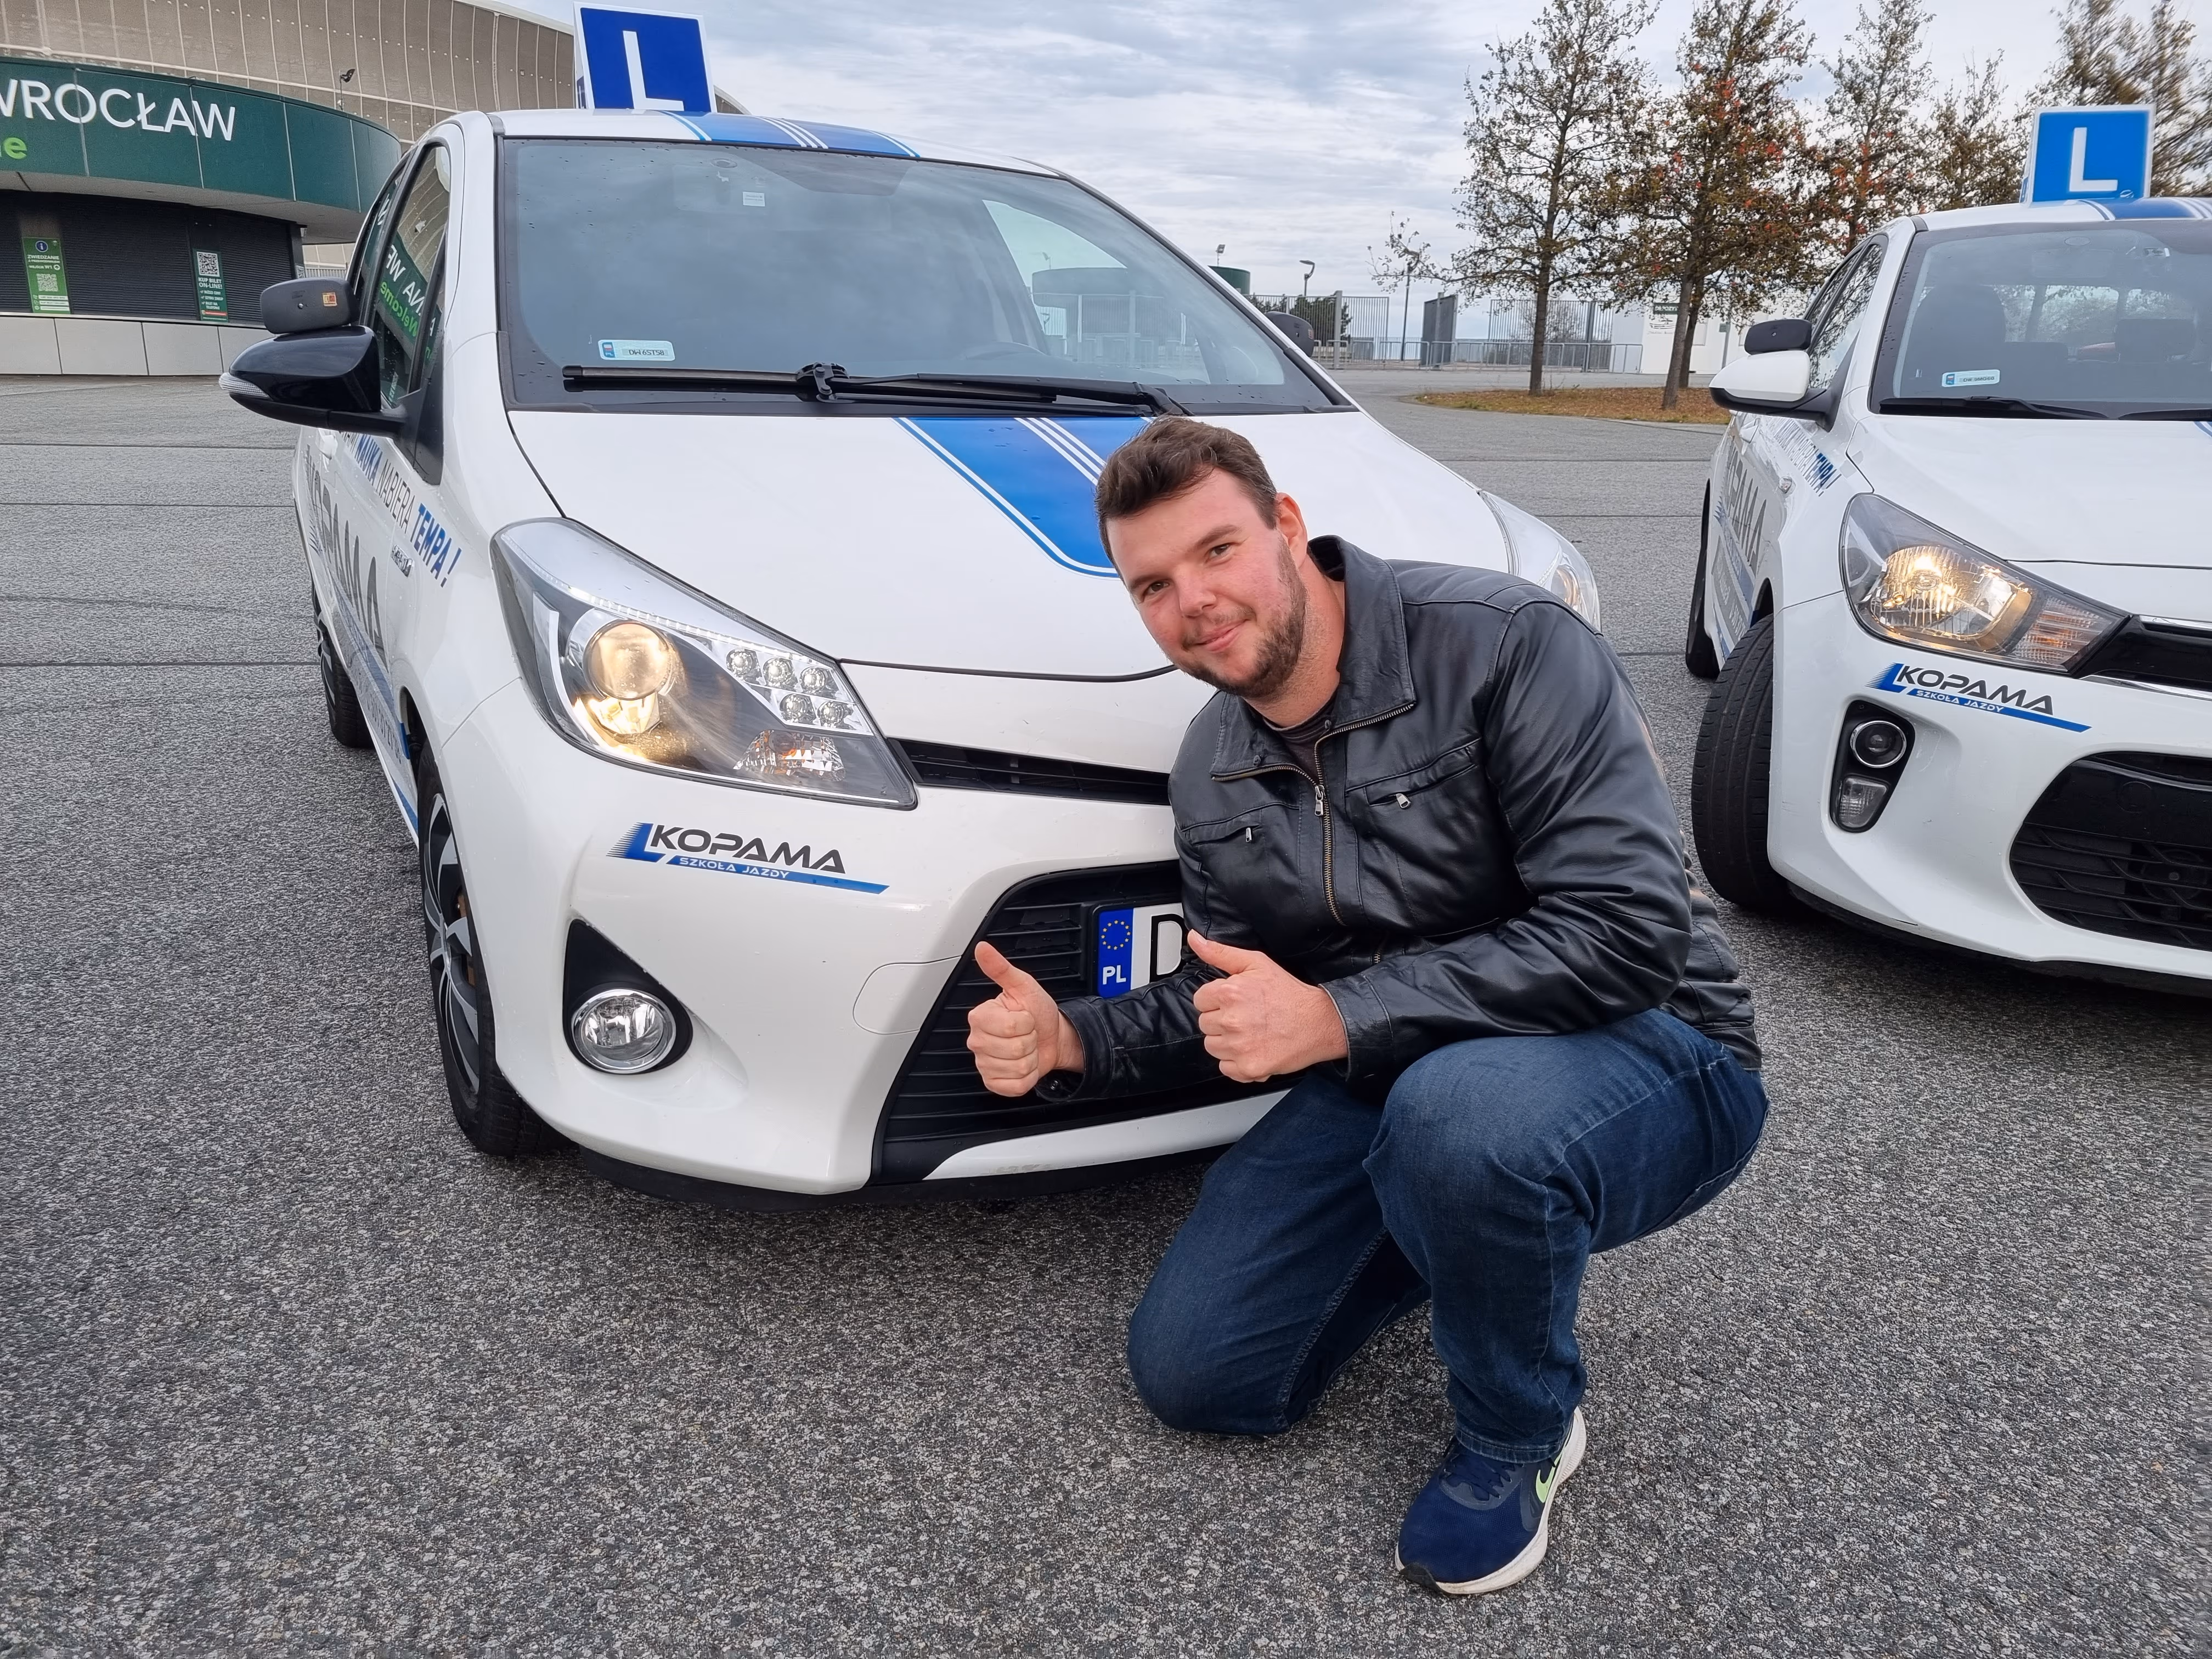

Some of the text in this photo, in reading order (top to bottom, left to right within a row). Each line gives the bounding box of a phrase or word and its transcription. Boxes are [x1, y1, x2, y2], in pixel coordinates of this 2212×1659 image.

[623, 30, 684, 111] L
[2069, 127, 2118, 192] L
[376, 459, 415, 534] NABIERA
[1896, 665, 2053, 715] KOPAMA
[1916, 690, 2005, 713] SZKOŁA JAZDY
[651, 825, 846, 874] KOPAMA
[679, 857, 790, 879] SZKOŁA JAZDY
[1102, 965, 1126, 985] PL
